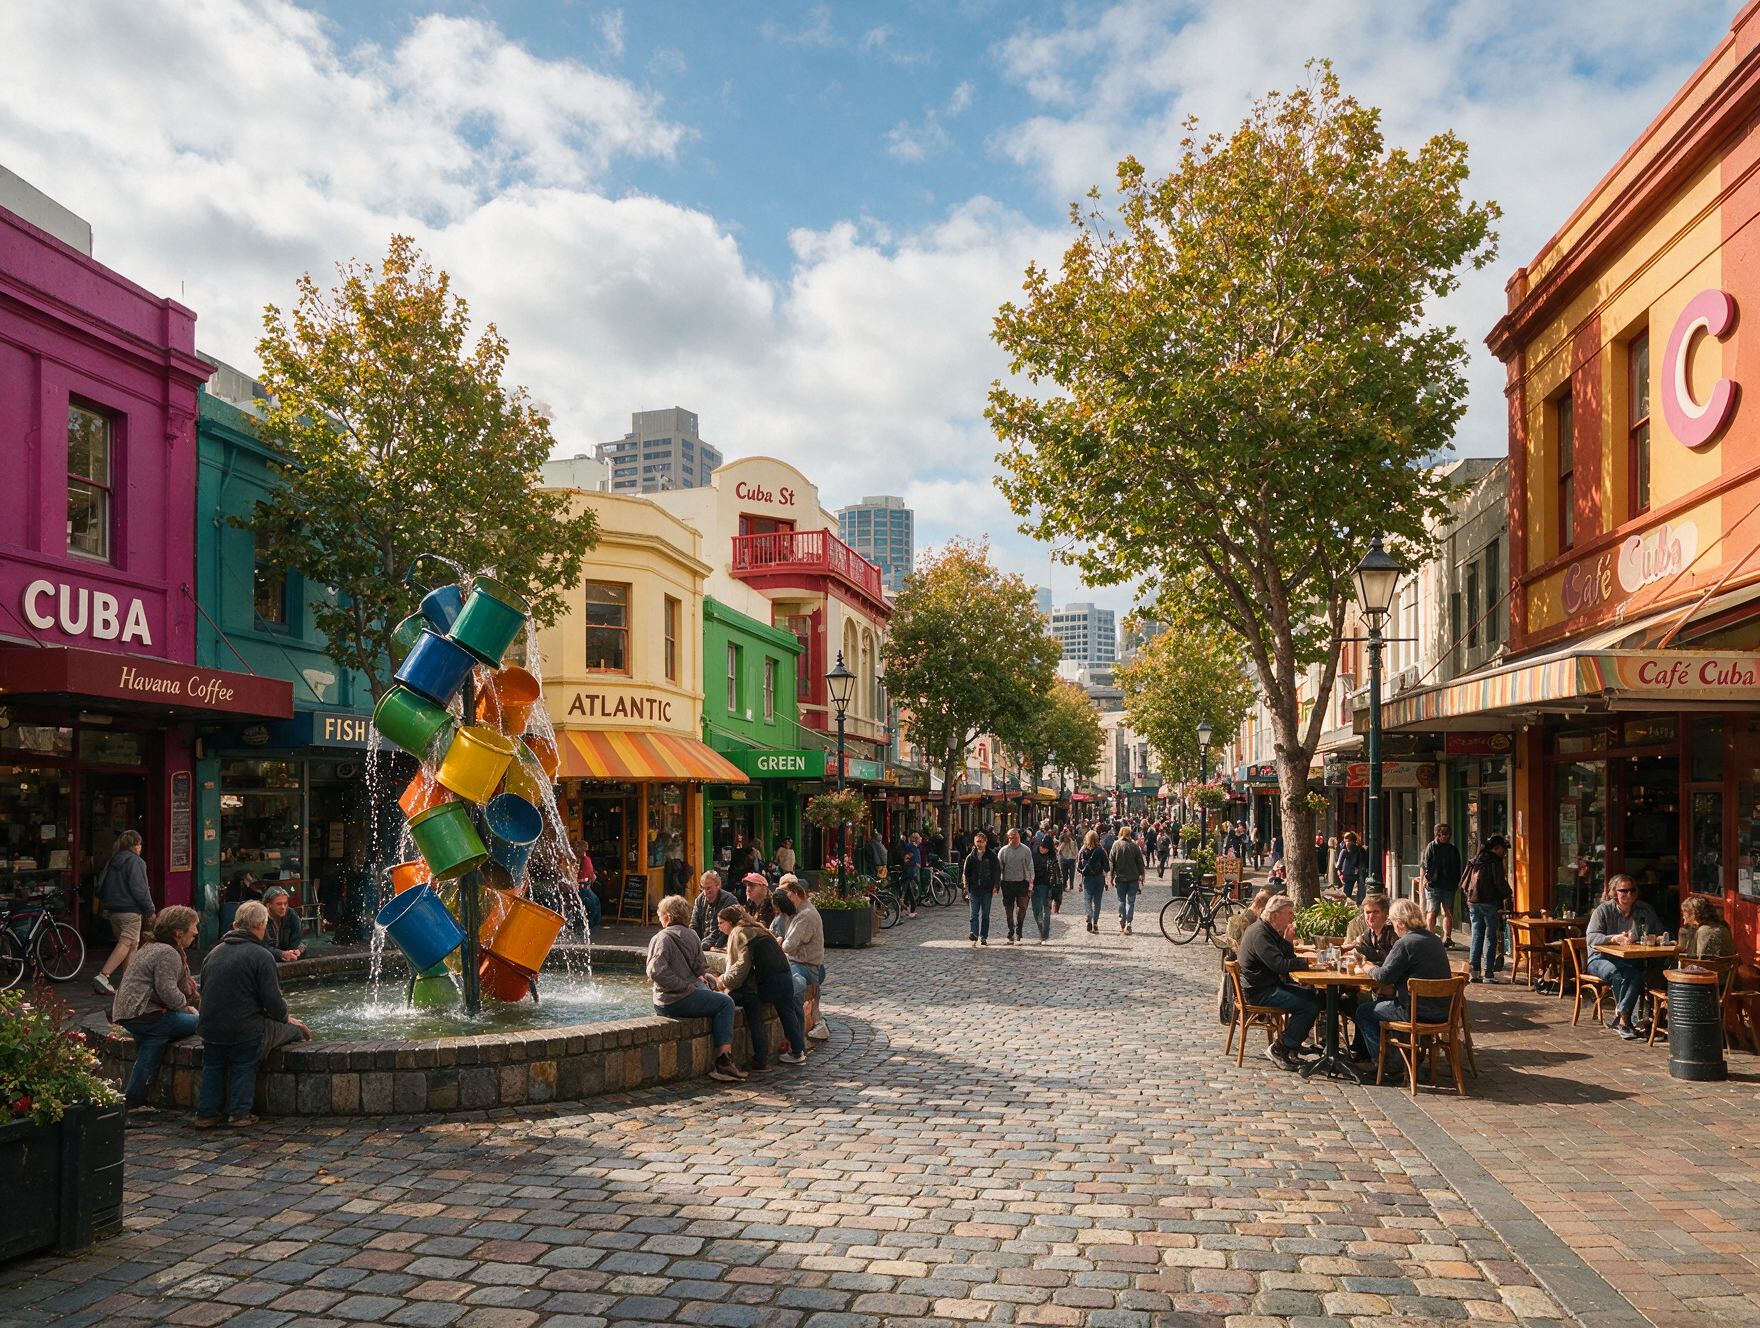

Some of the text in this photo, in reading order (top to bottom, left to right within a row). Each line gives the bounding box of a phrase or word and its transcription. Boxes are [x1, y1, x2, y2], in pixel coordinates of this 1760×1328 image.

[1661, 289, 1734, 447] C
[735, 481, 795, 506] Cuba St
[1561, 523, 1690, 614] Café Cuba
[24, 579, 152, 645] CUBA
[119, 666, 234, 704] Havana Coffee
[1638, 660, 1756, 689] Café Cuba
[568, 692, 672, 723] ATLANTIC
[325, 718, 365, 742] FISH
[757, 756, 805, 771] GREEN
